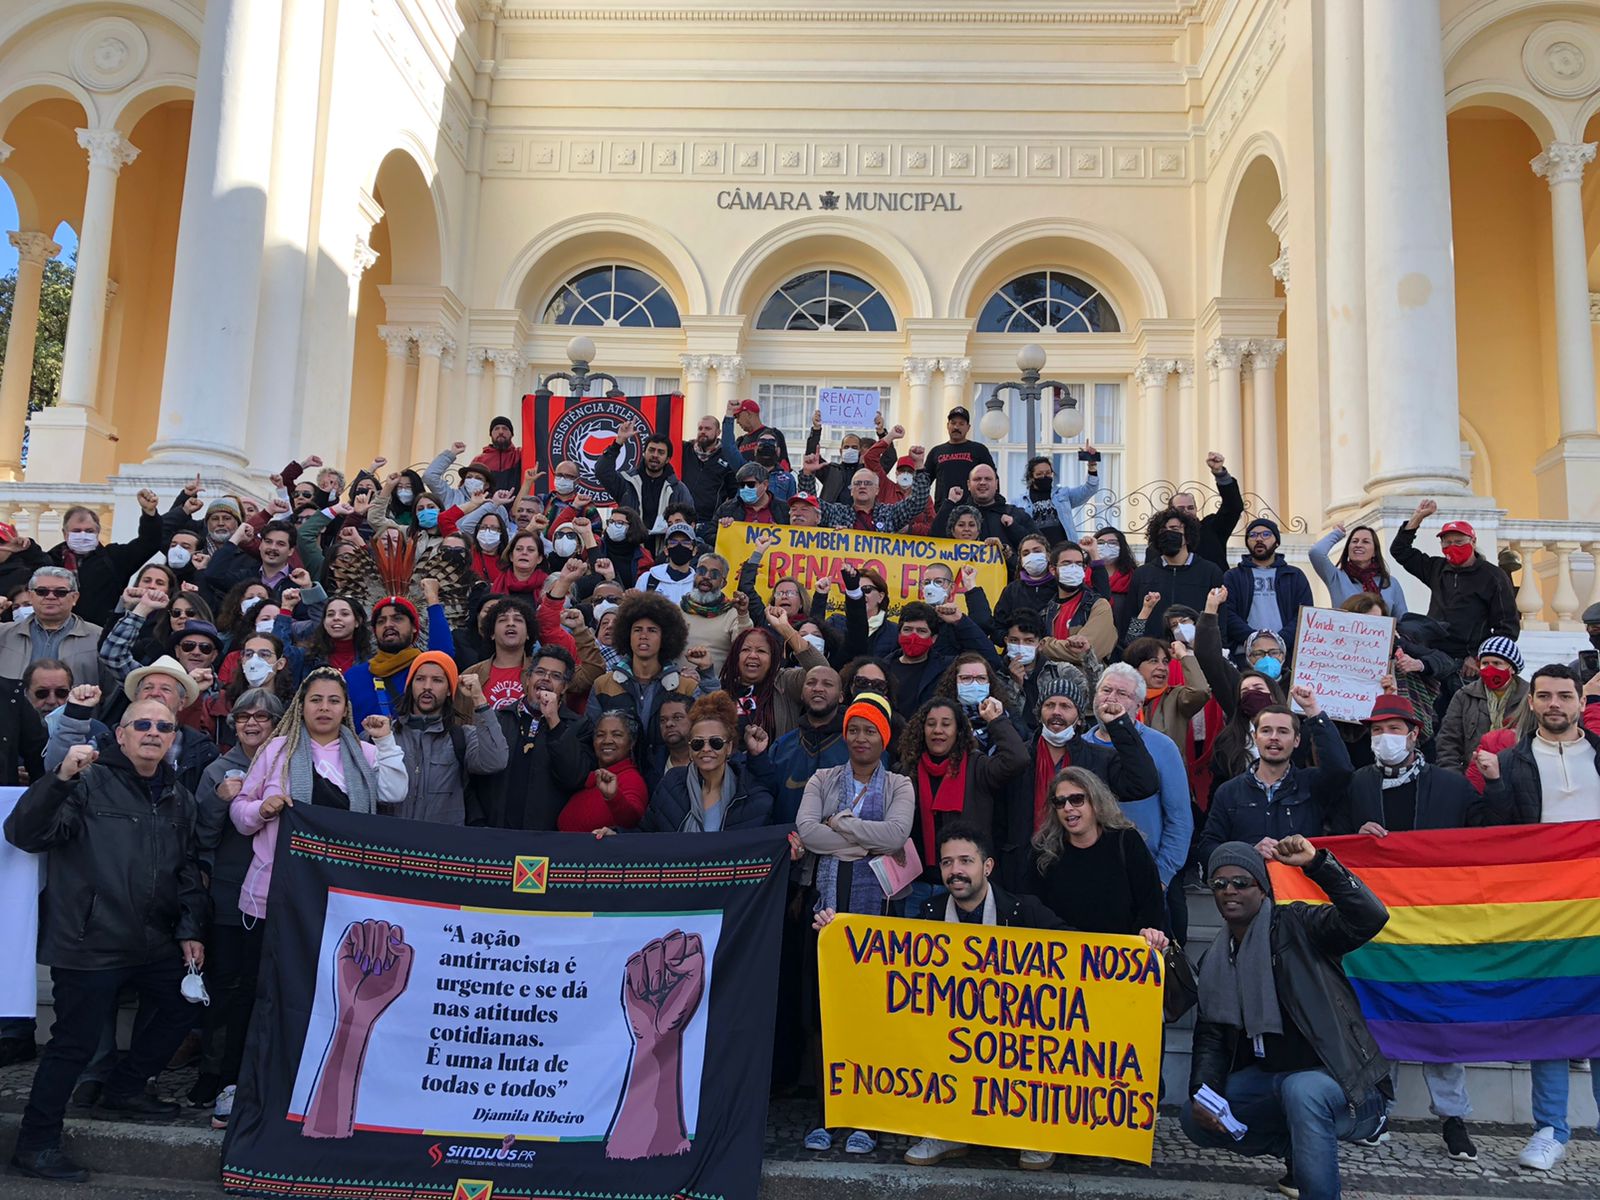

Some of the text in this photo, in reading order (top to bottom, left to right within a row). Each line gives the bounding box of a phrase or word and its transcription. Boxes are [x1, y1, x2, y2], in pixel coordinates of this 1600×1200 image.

[716, 187, 962, 211] CÂMARA MUNICIPAL
[822, 391, 874, 406] RENATO
[552, 403, 604, 455] RESISTÊNCIA
[854, 534, 937, 559] ENTRAMOS
[953, 543, 1004, 565] IGREJA
[901, 563, 968, 603] FIA
[1307, 611, 1335, 632] Vinde
[1353, 640, 1381, 654] que
[470, 930, 521, 950] ação
[439, 951, 577, 974] antirracista é
[844, 925, 1162, 987] VAMOS SALVAR NOSSA
[436, 977, 588, 999] urgente e se dá
[432, 1002, 558, 1024] nas atitudes
[886, 971, 1090, 1033] DEMOCRACIA
[429, 1025, 544, 1048] cotidianas.
[425, 1043, 569, 1074] É uma luta de
[948, 1026, 1144, 1082] SOBERANIA
[421, 1073, 480, 1096] todas
[484, 1082, 496, 1096] e
[830, 1062, 1155, 1131] E NOSSAS INSTITUIÇÕES
[472, 1107, 585, 1125] Djamila Ribeiro
